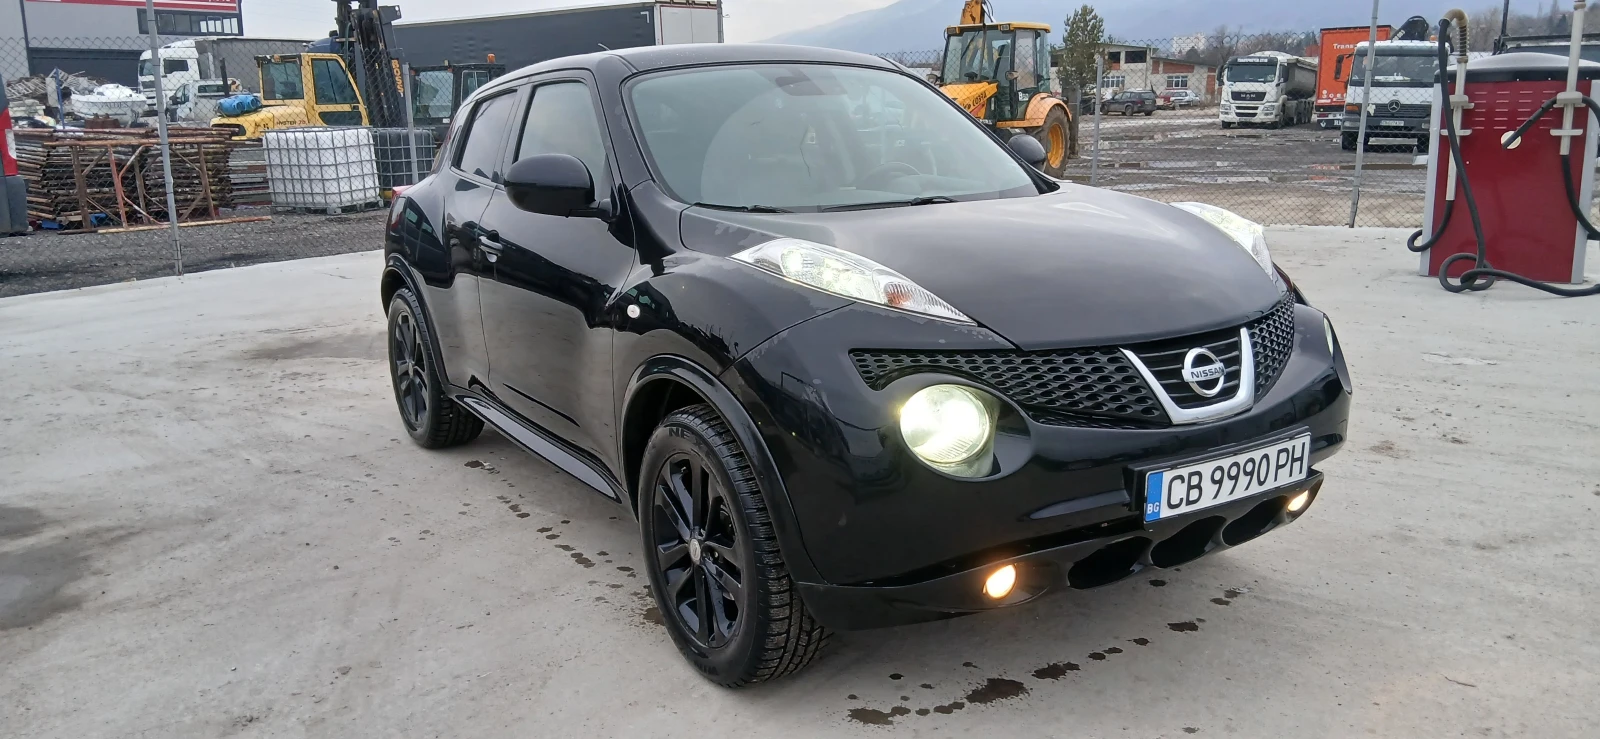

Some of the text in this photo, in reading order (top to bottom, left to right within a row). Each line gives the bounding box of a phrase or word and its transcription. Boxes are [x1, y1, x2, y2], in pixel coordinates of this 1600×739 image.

[1190, 366, 1225, 380] NISSAN
[1166, 441, 1306, 510] CB 9990 PH
[1147, 502, 1160, 514] BG
